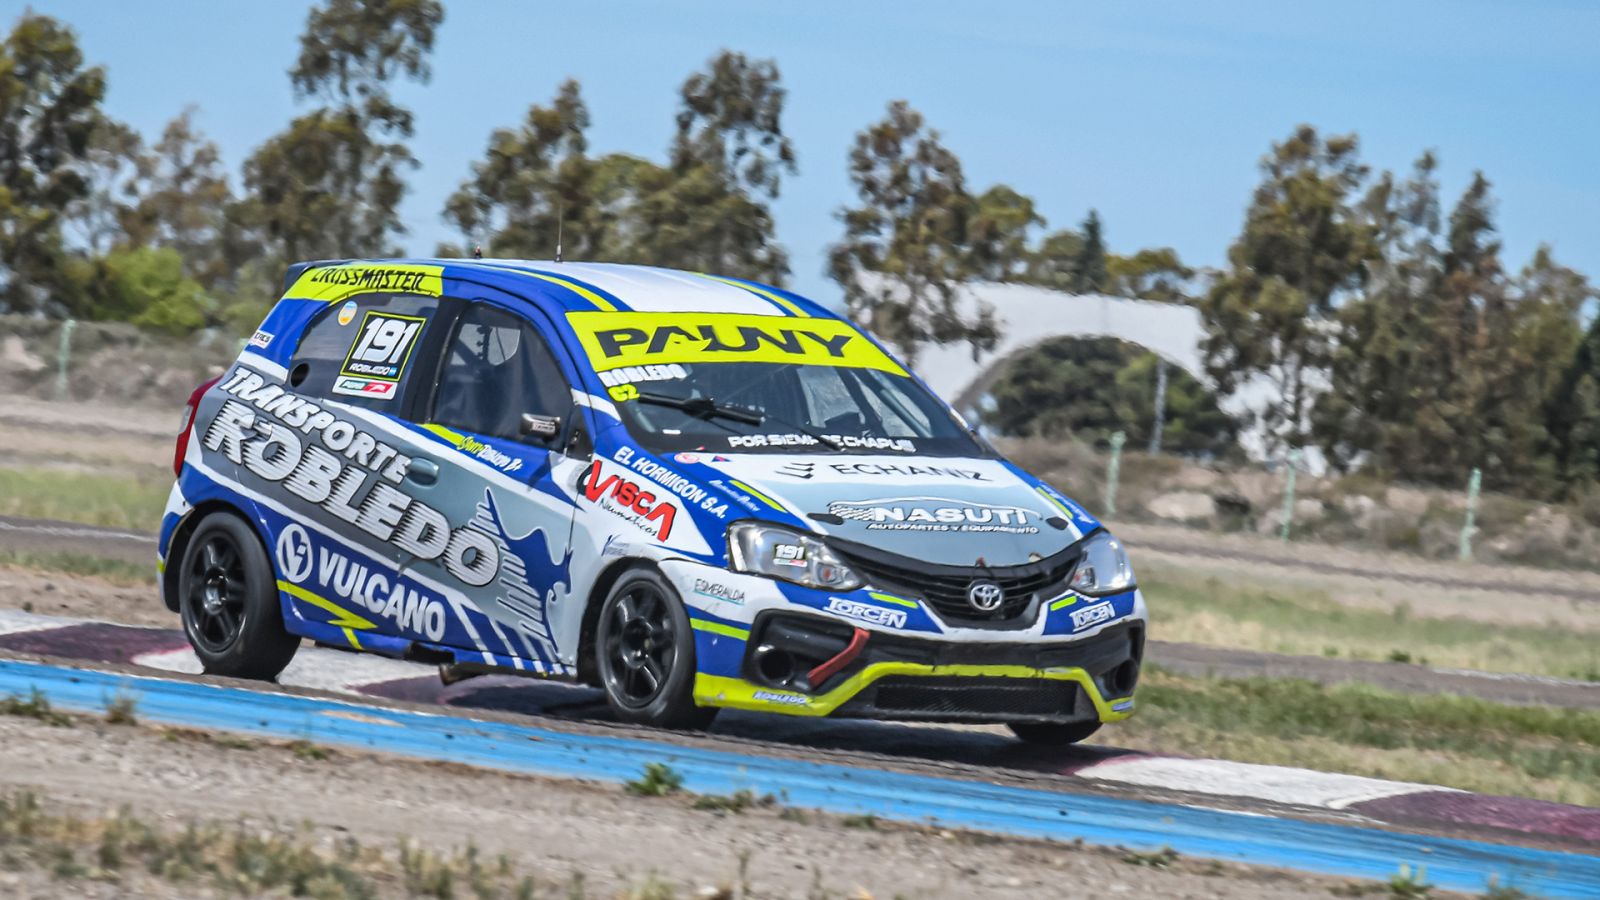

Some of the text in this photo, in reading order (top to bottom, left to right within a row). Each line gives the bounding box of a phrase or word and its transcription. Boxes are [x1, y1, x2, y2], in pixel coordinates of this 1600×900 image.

[310, 267, 426, 291] CROSSMASTER
[351, 317, 422, 364] 191
[594, 324, 853, 359] PAUNY
[349, 362, 391, 376] ROBLEDO
[597, 363, 689, 387] ROBLEDO
[608, 383, 641, 402] C2
[219, 365, 412, 484] TRANSPORTE
[727, 434, 768, 448] POR
[613, 445, 631, 466] EL
[630, 457, 704, 505] HORMIGON
[702, 493, 731, 519] S.A.
[830, 463, 993, 482] ECHANIZ
[202, 399, 500, 587] ROBLEDO
[584, 459, 677, 543] VISCA
[866, 522, 950, 533] AUTOPARTES
[961, 523, 1040, 534] EQUIPAMIENTO
[873, 507, 1029, 525] NASUTI
[774, 544, 806, 560] 191
[318, 545, 446, 643] VULCANO
[694, 577, 746, 603] ESMERALDA
[823, 597, 908, 629] TORCEN
[1069, 601, 1116, 633] TORCEN
